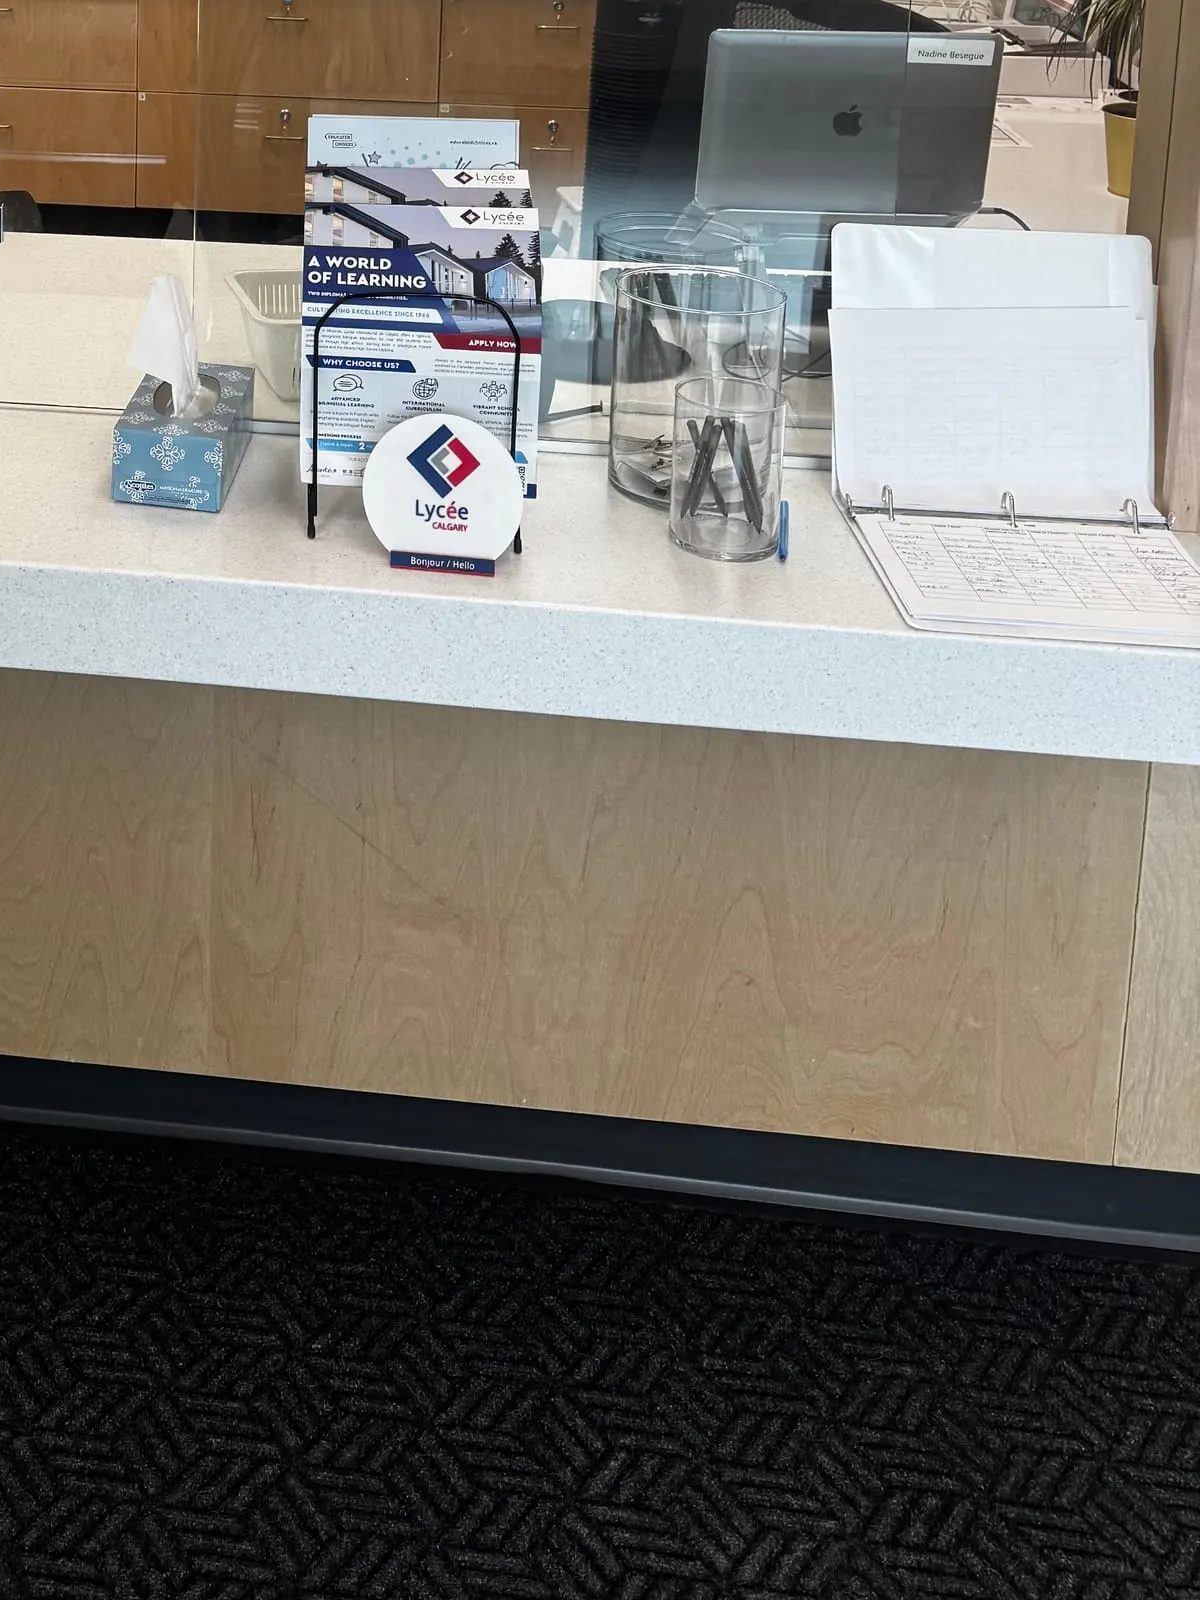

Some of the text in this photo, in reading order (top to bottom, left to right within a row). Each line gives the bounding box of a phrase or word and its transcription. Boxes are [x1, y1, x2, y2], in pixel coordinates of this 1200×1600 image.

[917, 50, 948, 59] Nadine
[475, 172, 516, 185] Lycée
[483, 211, 525, 225] Lycée
[308, 255, 392, 270] A WORLD
[307, 271, 427, 289] OF LEARNING
[351, 308, 393, 317] EXCELLENCE
[394, 310, 413, 318] SINCE
[468, 339, 517, 349] APPLY NOW
[322, 358, 400, 369] WHY CHOOSE US?
[359, 442, 366, 451] 2
[415, 498, 469, 522] Lycée
[432, 521, 468, 532] CALGARY
[410, 556, 475, 571] Bonjour / Hello
